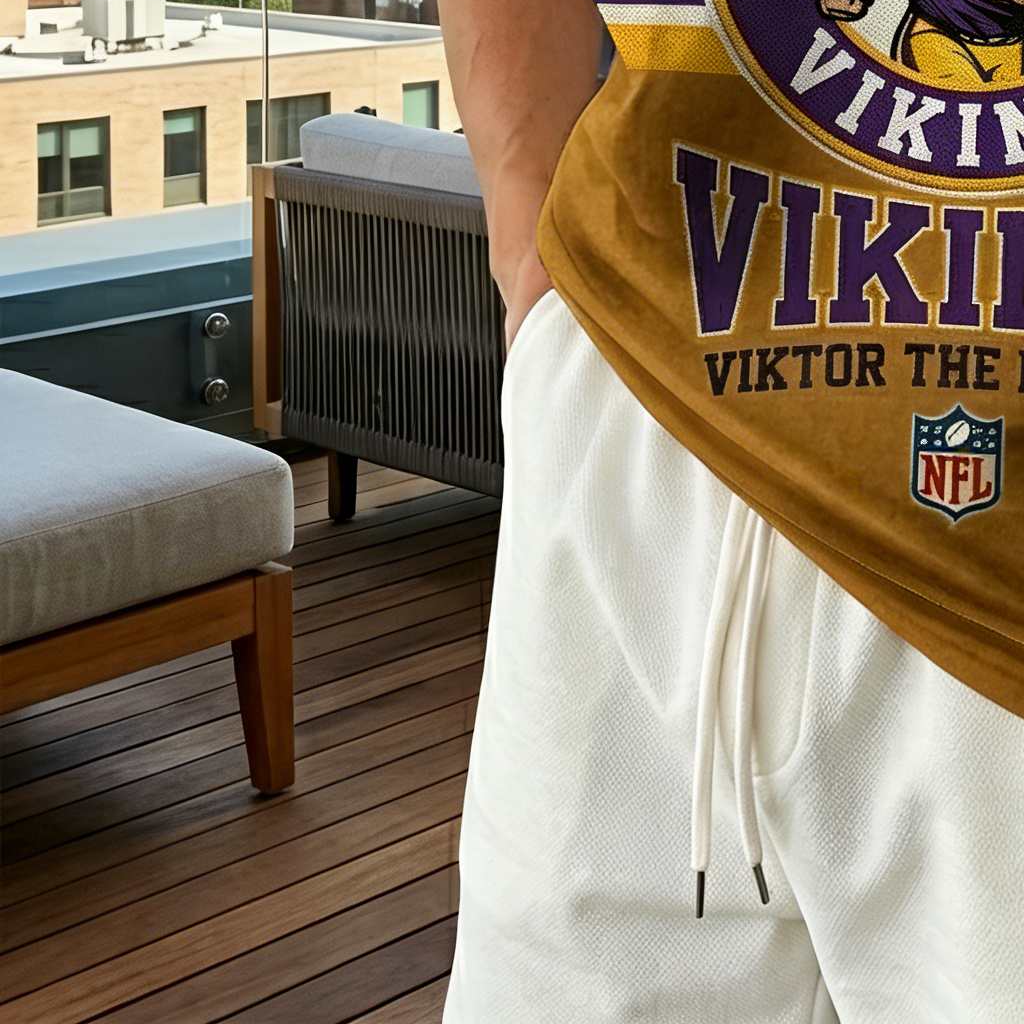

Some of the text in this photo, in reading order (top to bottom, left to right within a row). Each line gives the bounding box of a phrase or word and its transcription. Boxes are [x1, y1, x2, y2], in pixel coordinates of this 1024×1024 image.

[704, 344, 886, 396] VIKTOR
[904, 344, 1001, 391] THE
[919, 454, 993, 505] NFL
